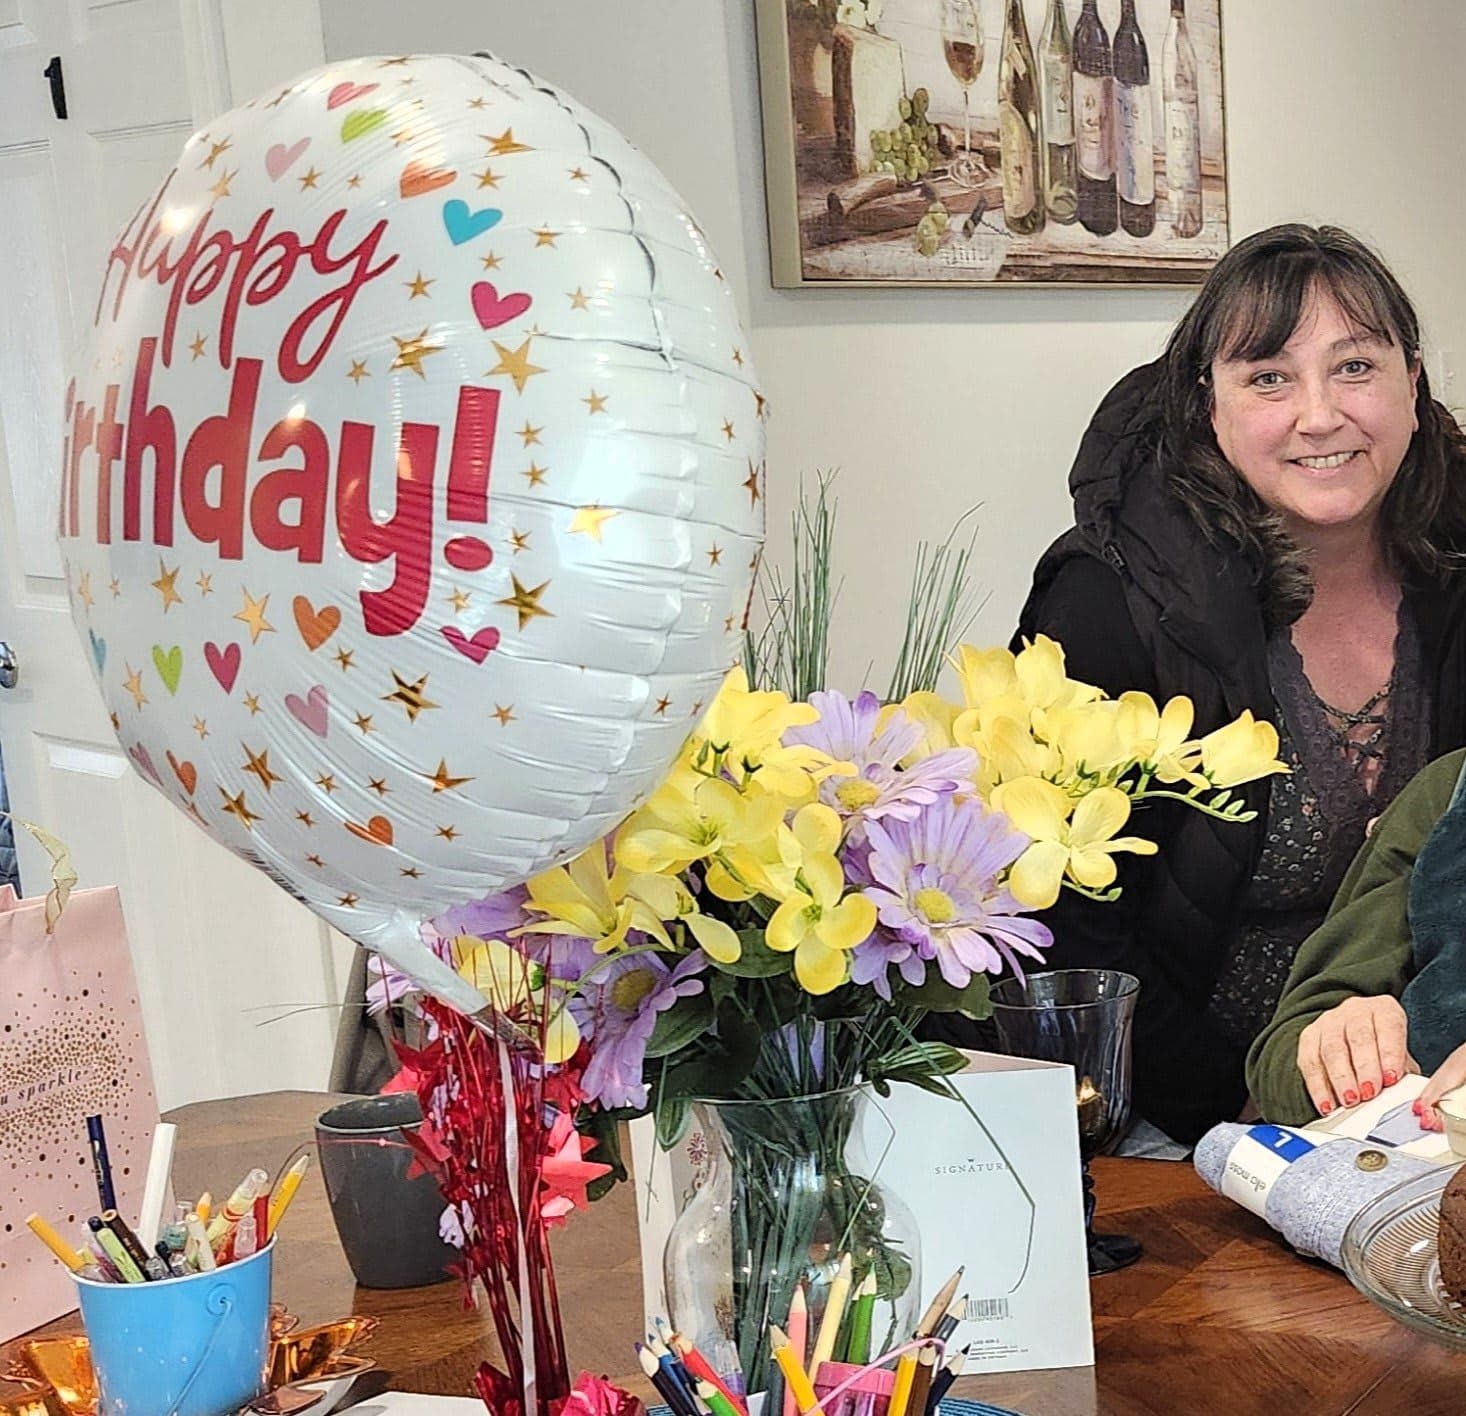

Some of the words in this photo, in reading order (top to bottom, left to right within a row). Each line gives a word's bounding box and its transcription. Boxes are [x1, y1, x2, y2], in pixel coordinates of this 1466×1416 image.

[95, 168, 401, 383] Happy
[57, 337, 502, 637] irthday!
[17, 1068, 82, 1102] sparkle
[1273, 1131, 1294, 1148] L
